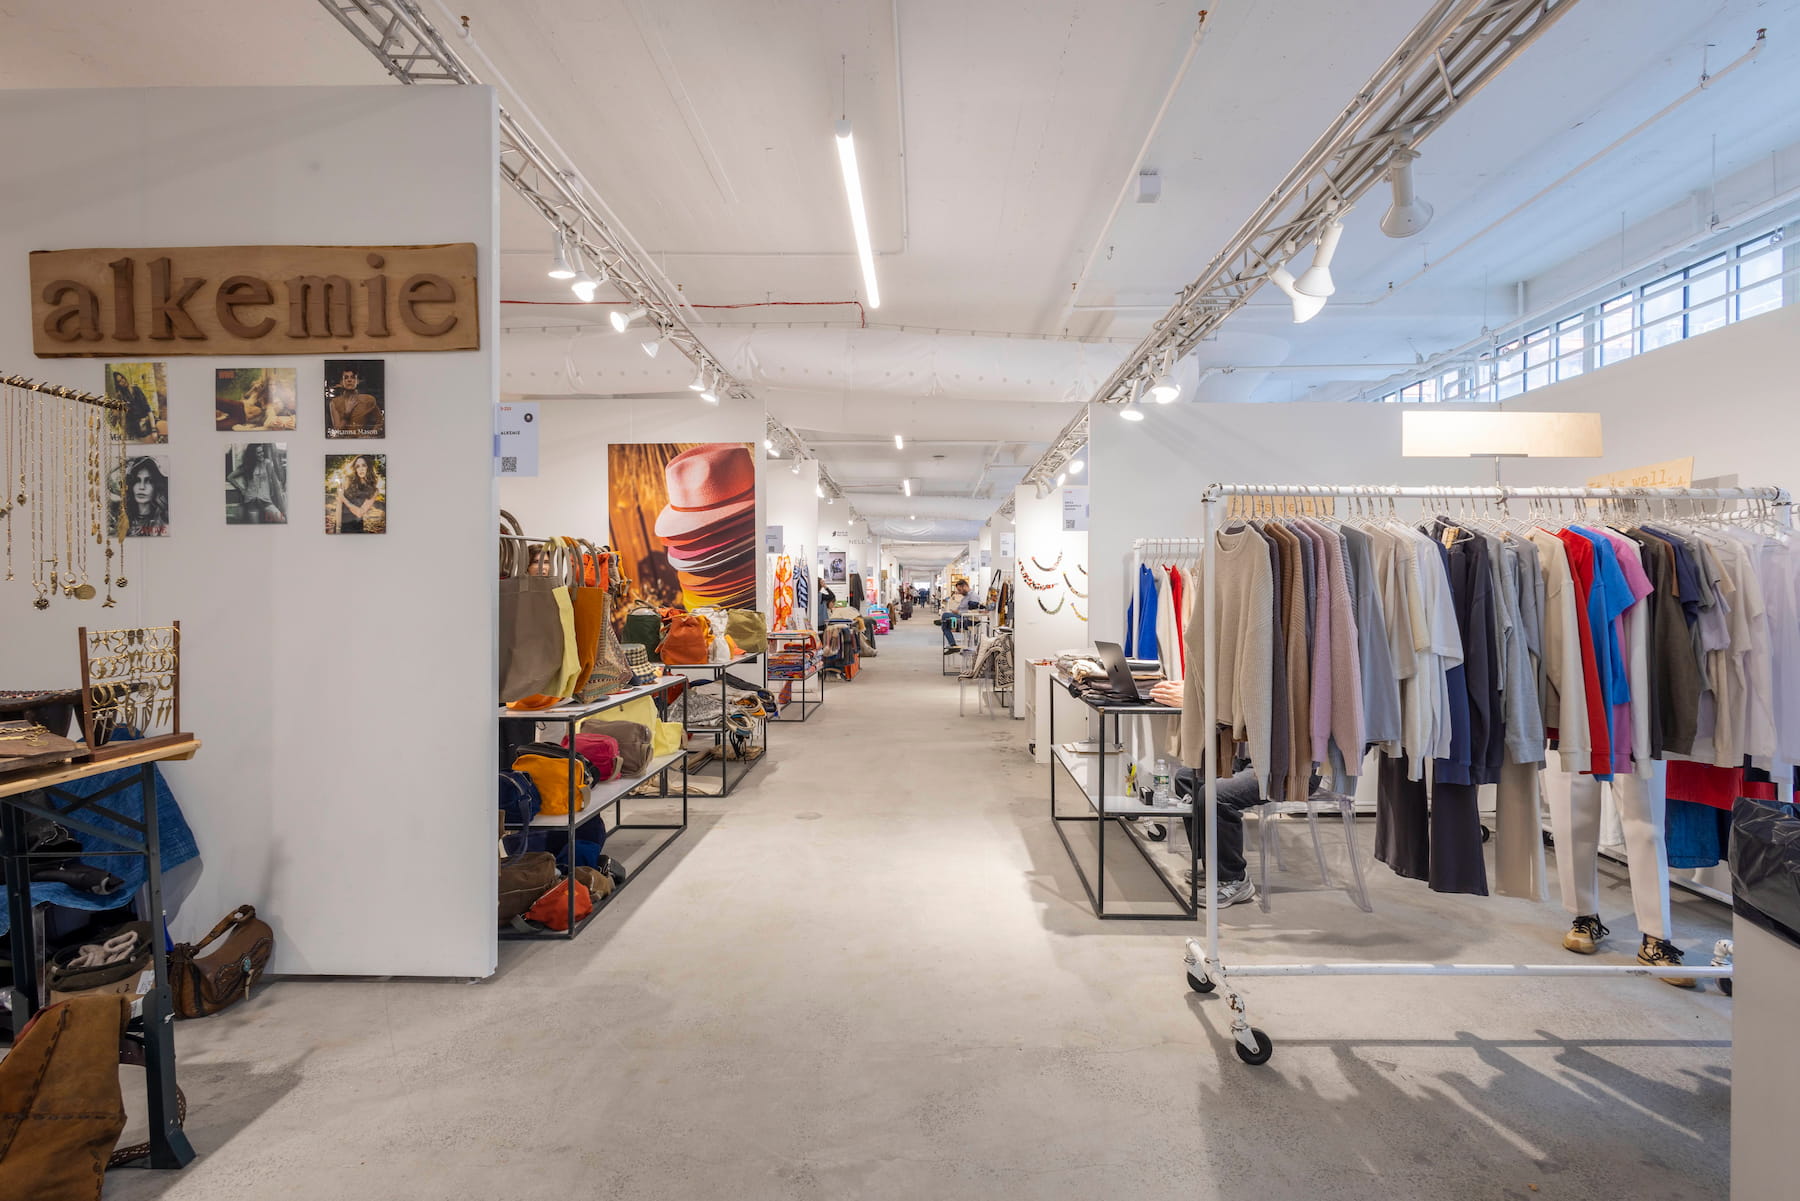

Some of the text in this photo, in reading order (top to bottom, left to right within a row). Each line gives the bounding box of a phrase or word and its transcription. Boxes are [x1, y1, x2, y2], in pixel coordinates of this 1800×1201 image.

[42, 253, 459, 342] alkemie
[1631, 469, 1666, 488] well
[1279, 500, 1314, 513] el
